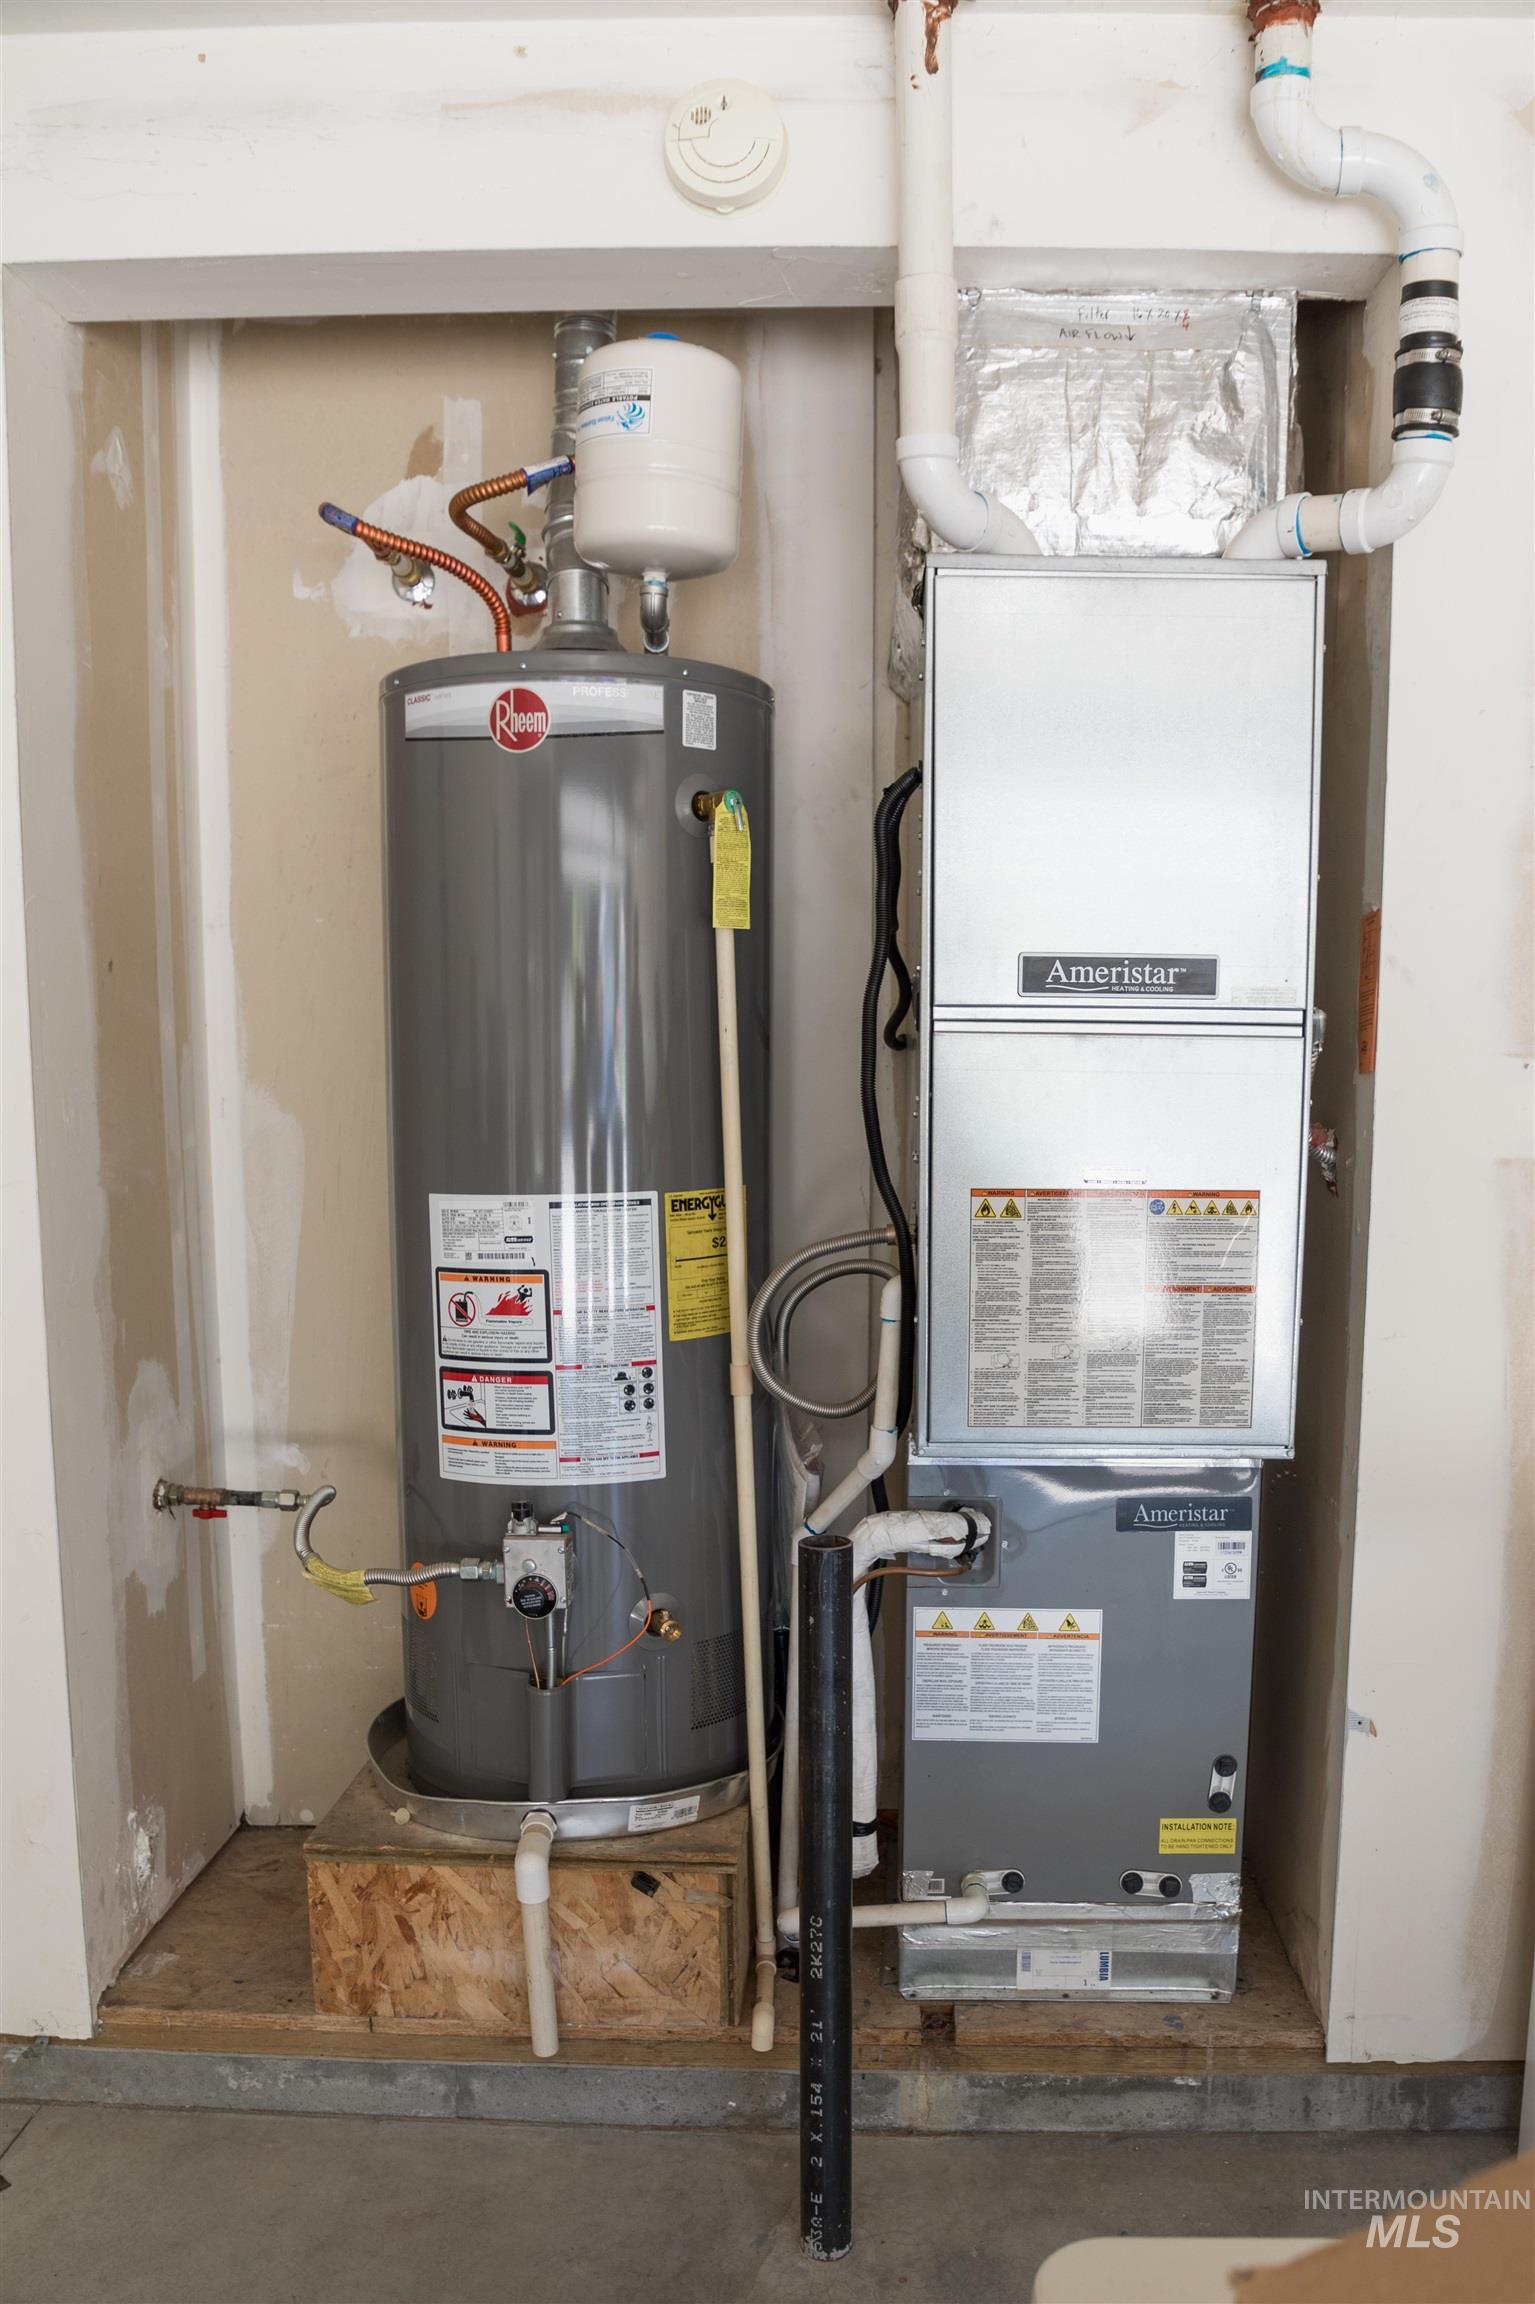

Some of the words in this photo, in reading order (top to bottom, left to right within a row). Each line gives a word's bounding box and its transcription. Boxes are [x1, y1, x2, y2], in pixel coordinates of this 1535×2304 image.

[1077, 305, 1110, 321] Filter
[1059, 327, 1080, 339] AIR
[1084, 328, 1122, 341] FLOW
[571, 685, 632, 698] PROFESS
[406, 693, 431, 706] CLASSIC
[495, 689, 547, 742] Rheem
[1045, 959, 1179, 985] Ameristar
[472, 1275, 511, 1283] WARNING
[479, 1376, 512, 1384] DANGER
[1133, 1503, 1229, 1523] Ameristar
[1099, 1952, 1110, 1981] LUMBIA
[810, 2155, 823, 2167] 2
